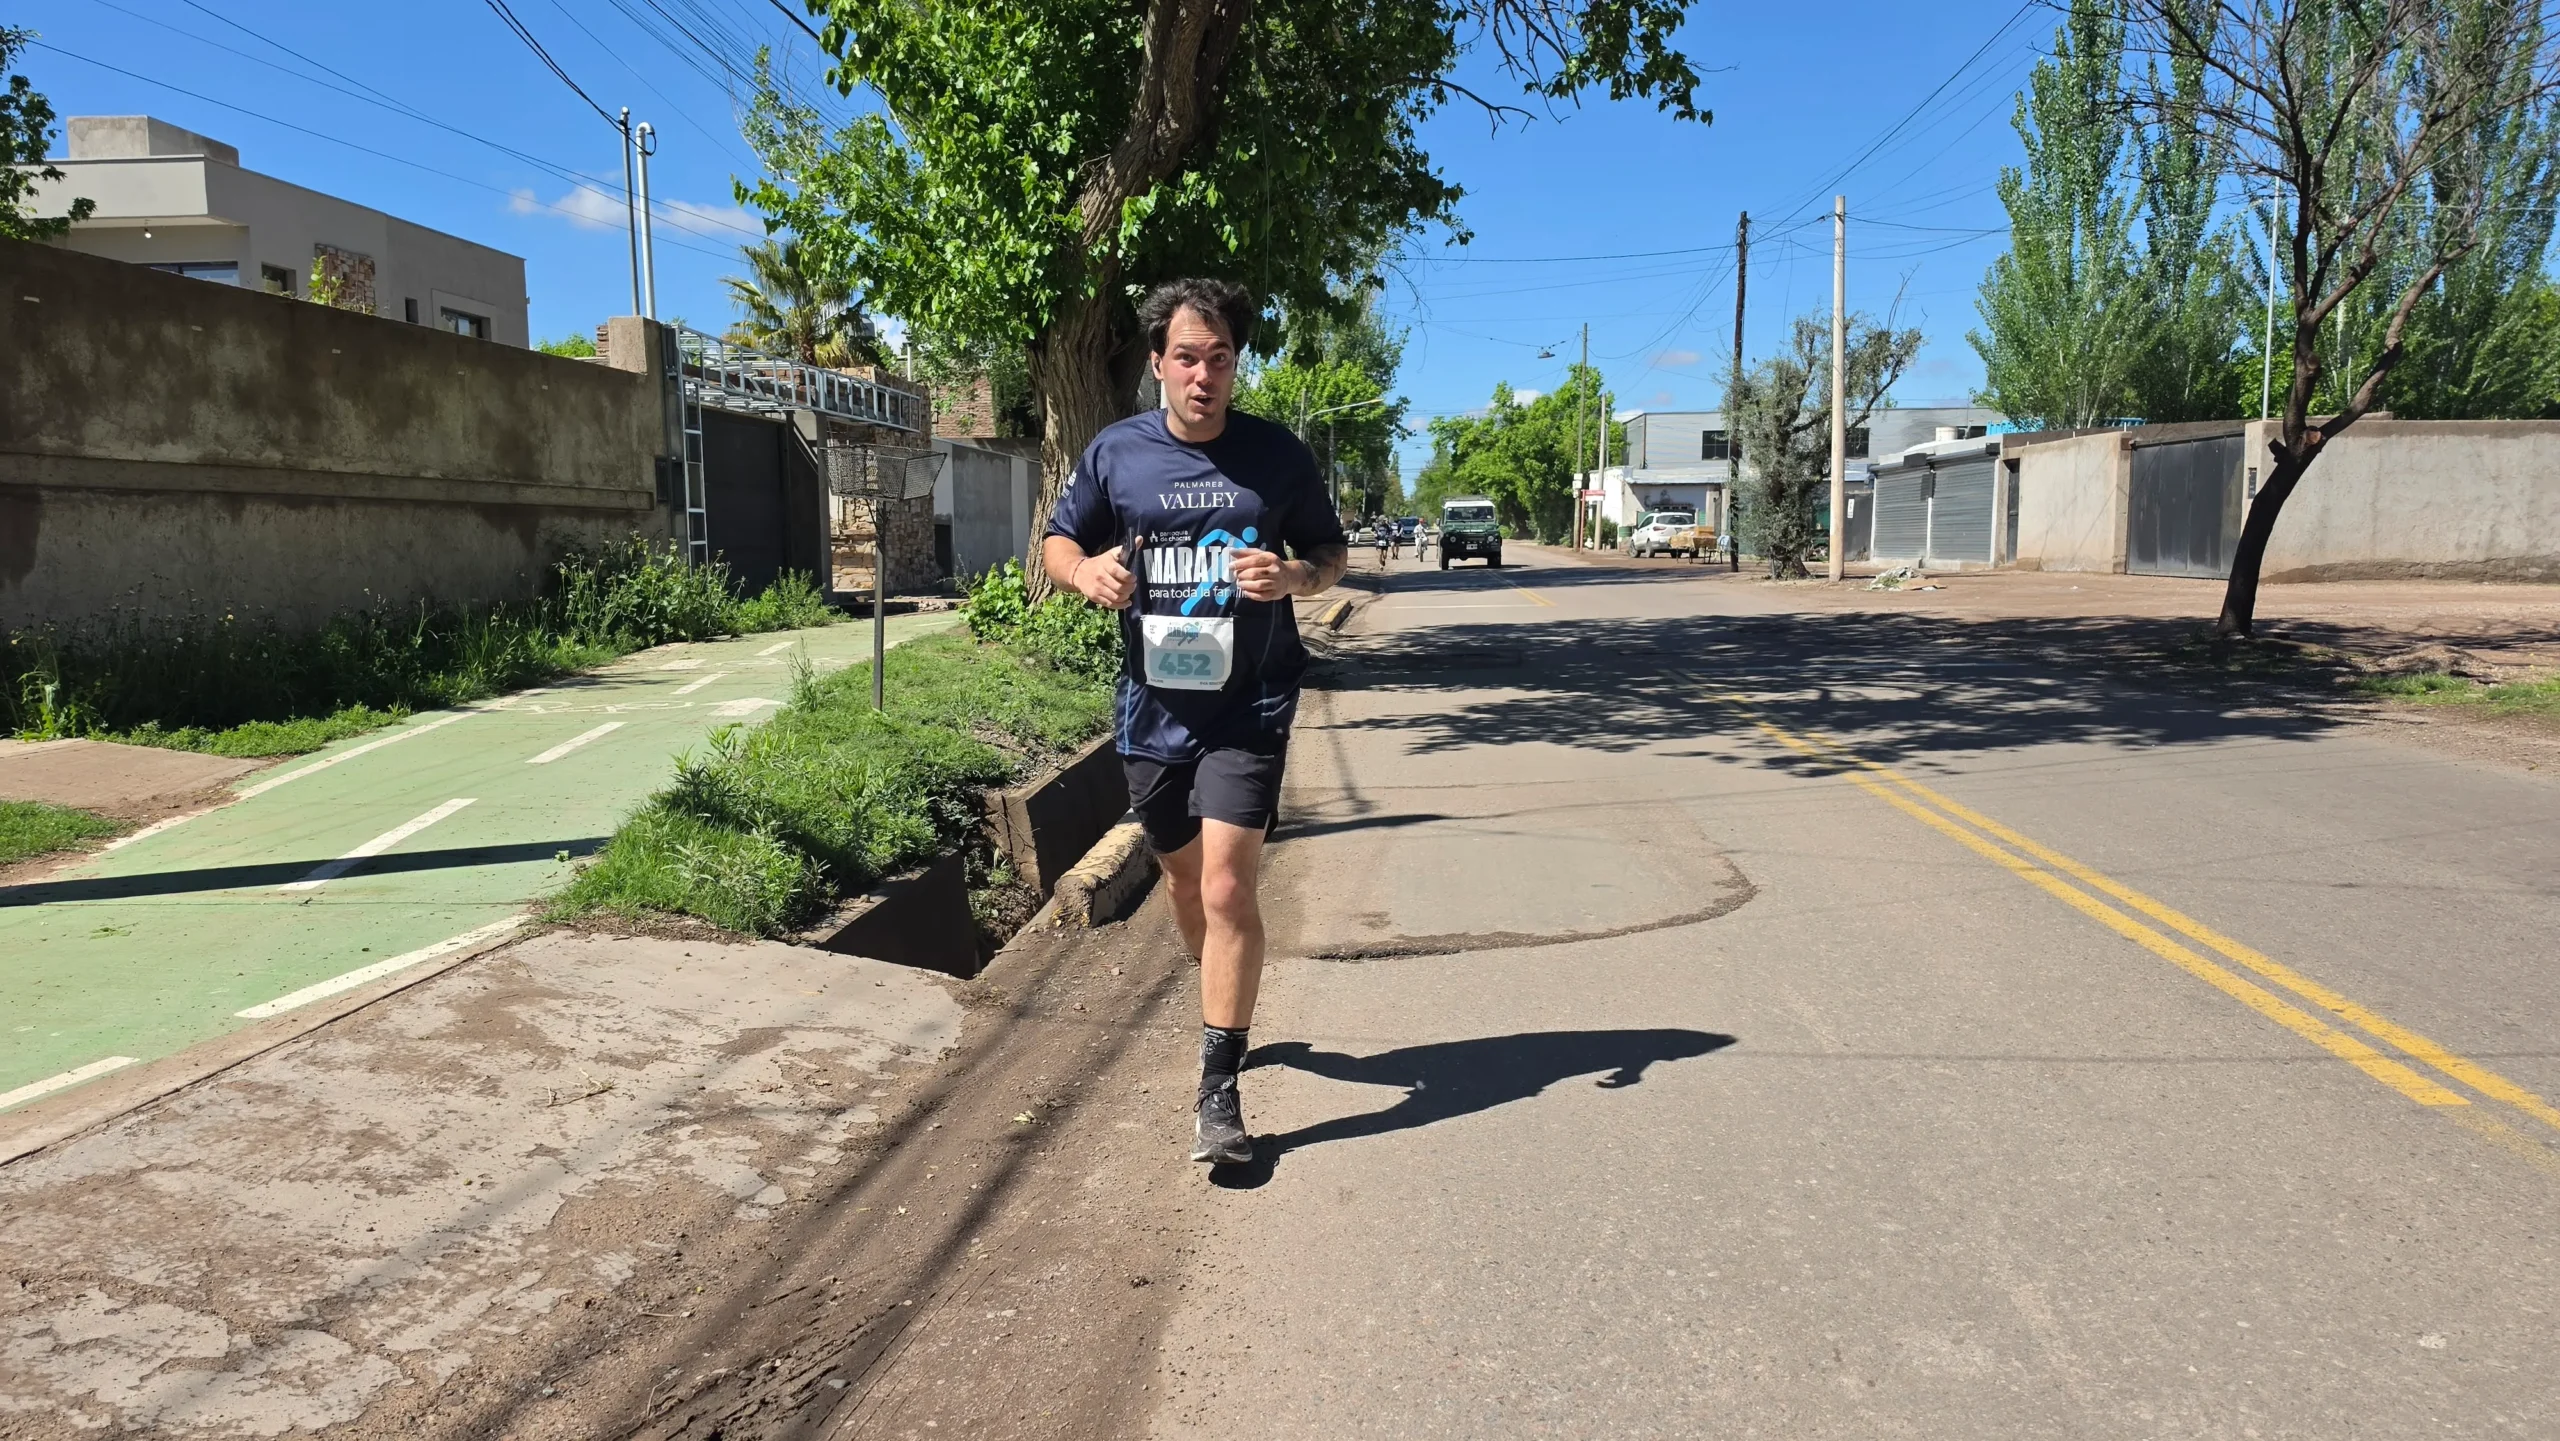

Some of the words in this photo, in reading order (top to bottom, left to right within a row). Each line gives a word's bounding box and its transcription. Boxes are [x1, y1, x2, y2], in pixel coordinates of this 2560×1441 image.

[1174, 481, 1223, 489] PALMARES
[1158, 491, 1239, 510] VALLEY
[1149, 588, 1169, 600] para
[1171, 586, 1198, 599] toda
[1201, 586, 1210, 598] la
[1158, 652, 1211, 676] 452
